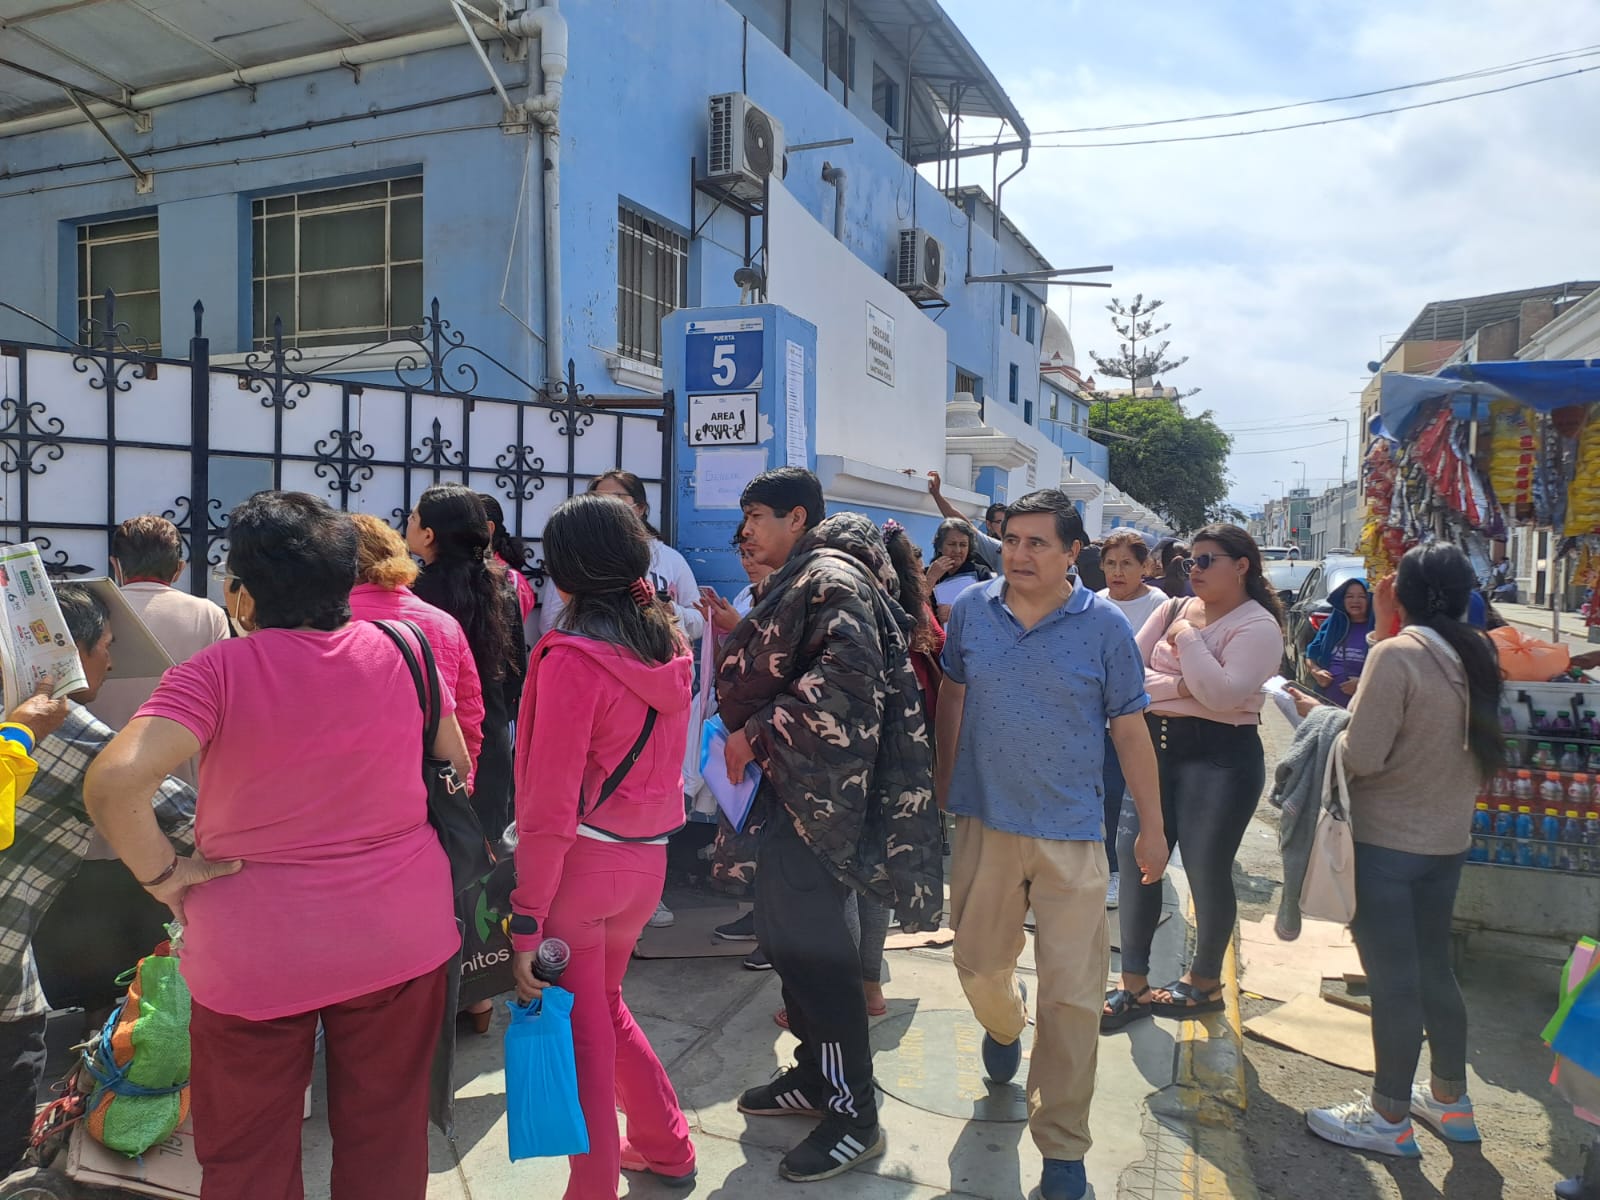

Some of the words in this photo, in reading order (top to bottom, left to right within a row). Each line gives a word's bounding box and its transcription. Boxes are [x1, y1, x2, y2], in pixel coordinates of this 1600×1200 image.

[713, 334, 735, 342] PUERTA
[711, 343, 737, 386] 5
[710, 411, 735, 421] AREA
[460, 948, 511, 976] nitos
